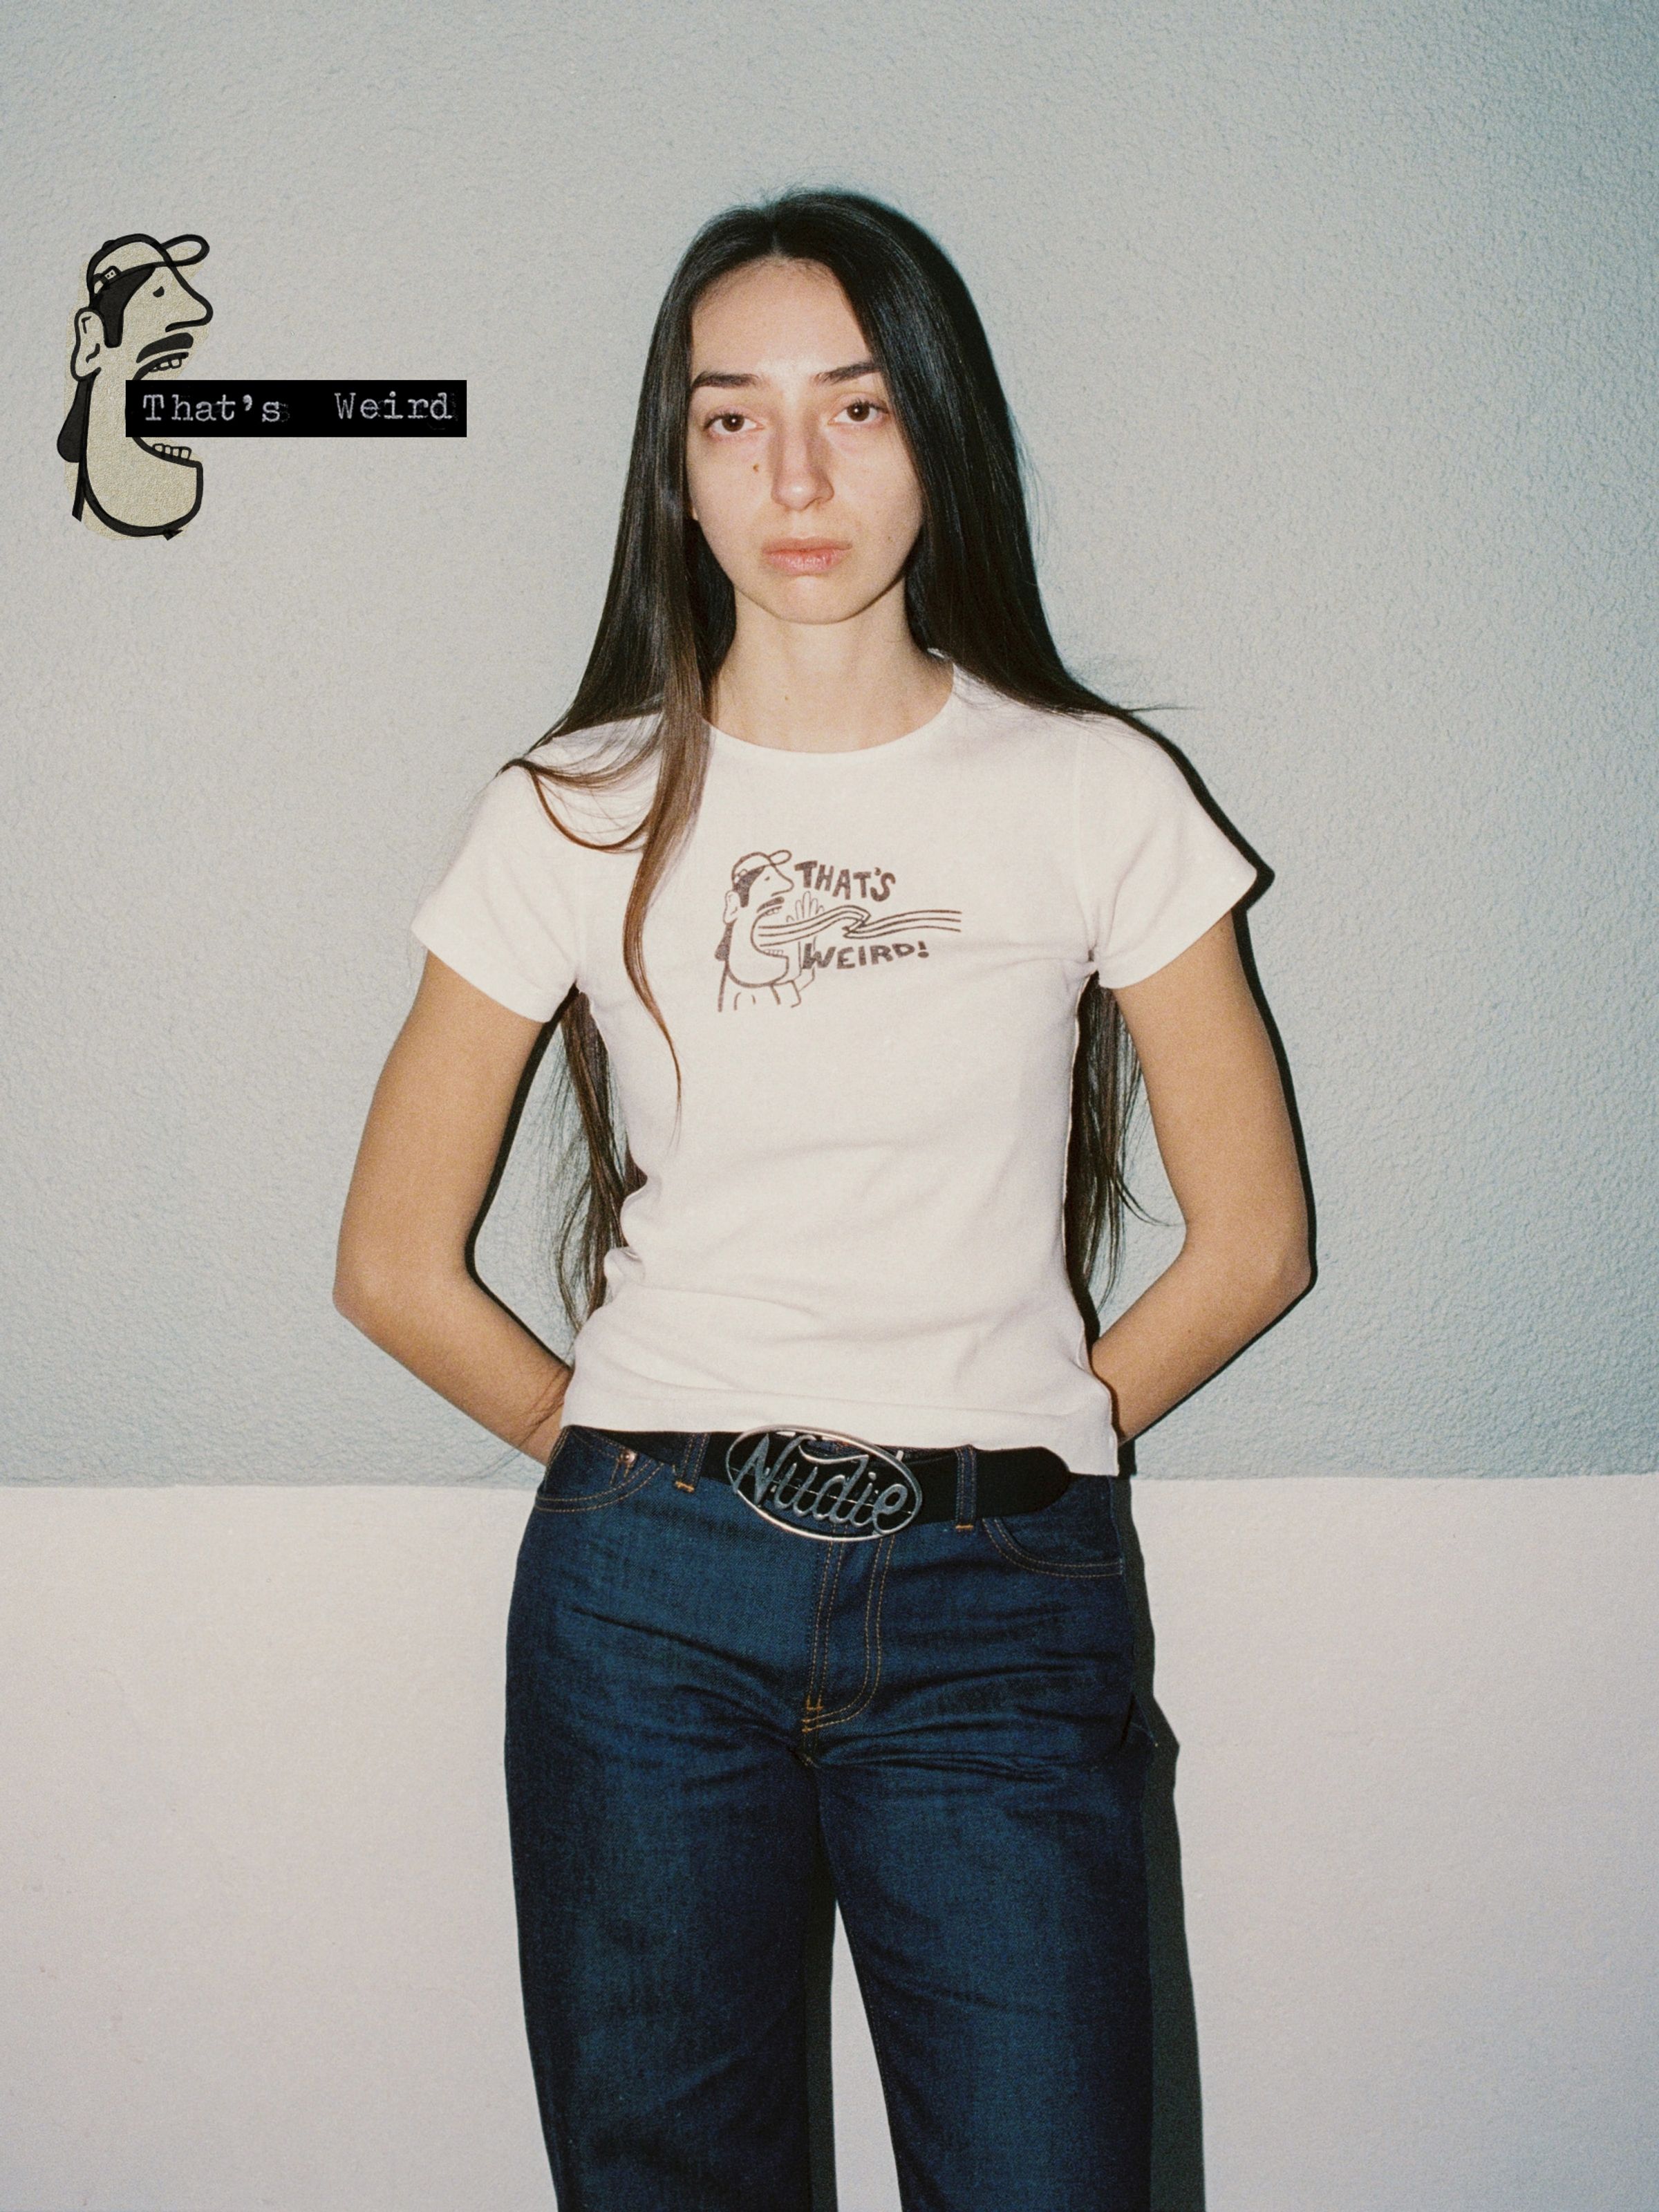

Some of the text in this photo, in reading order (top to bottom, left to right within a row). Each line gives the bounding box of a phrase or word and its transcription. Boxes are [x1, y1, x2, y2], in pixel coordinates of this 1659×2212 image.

[794, 860, 896, 902] THAT'S
[802, 940, 930, 969] WEIRD!
[734, 1433, 911, 1535] Nudie
